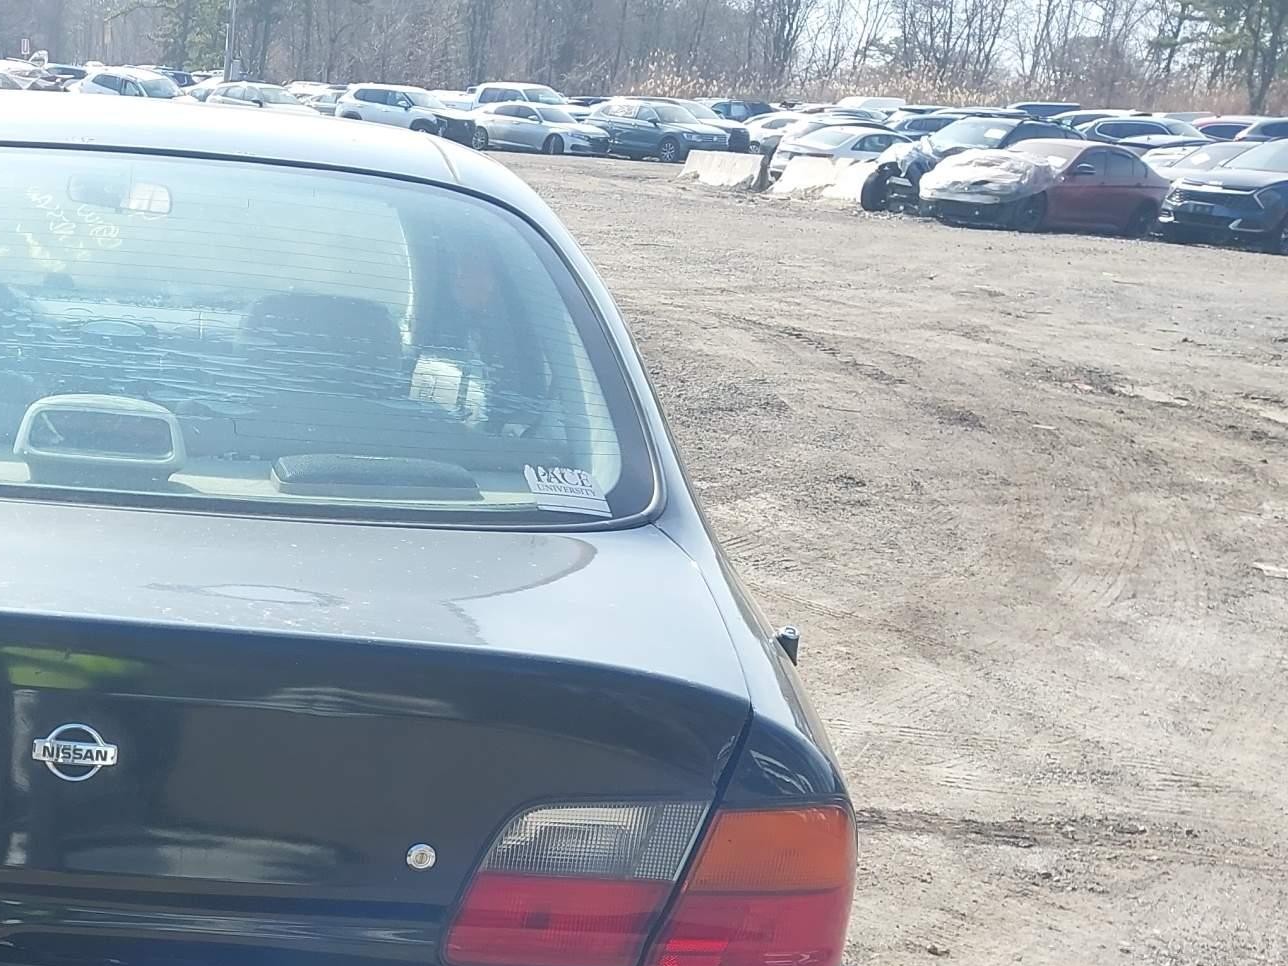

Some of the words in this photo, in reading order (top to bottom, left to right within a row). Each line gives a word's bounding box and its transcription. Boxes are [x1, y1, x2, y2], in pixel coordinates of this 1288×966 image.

[532, 466, 593, 488] PACE
[537, 483, 597, 497] UNIVERSITY
[42, 745, 108, 762] NISSAN
